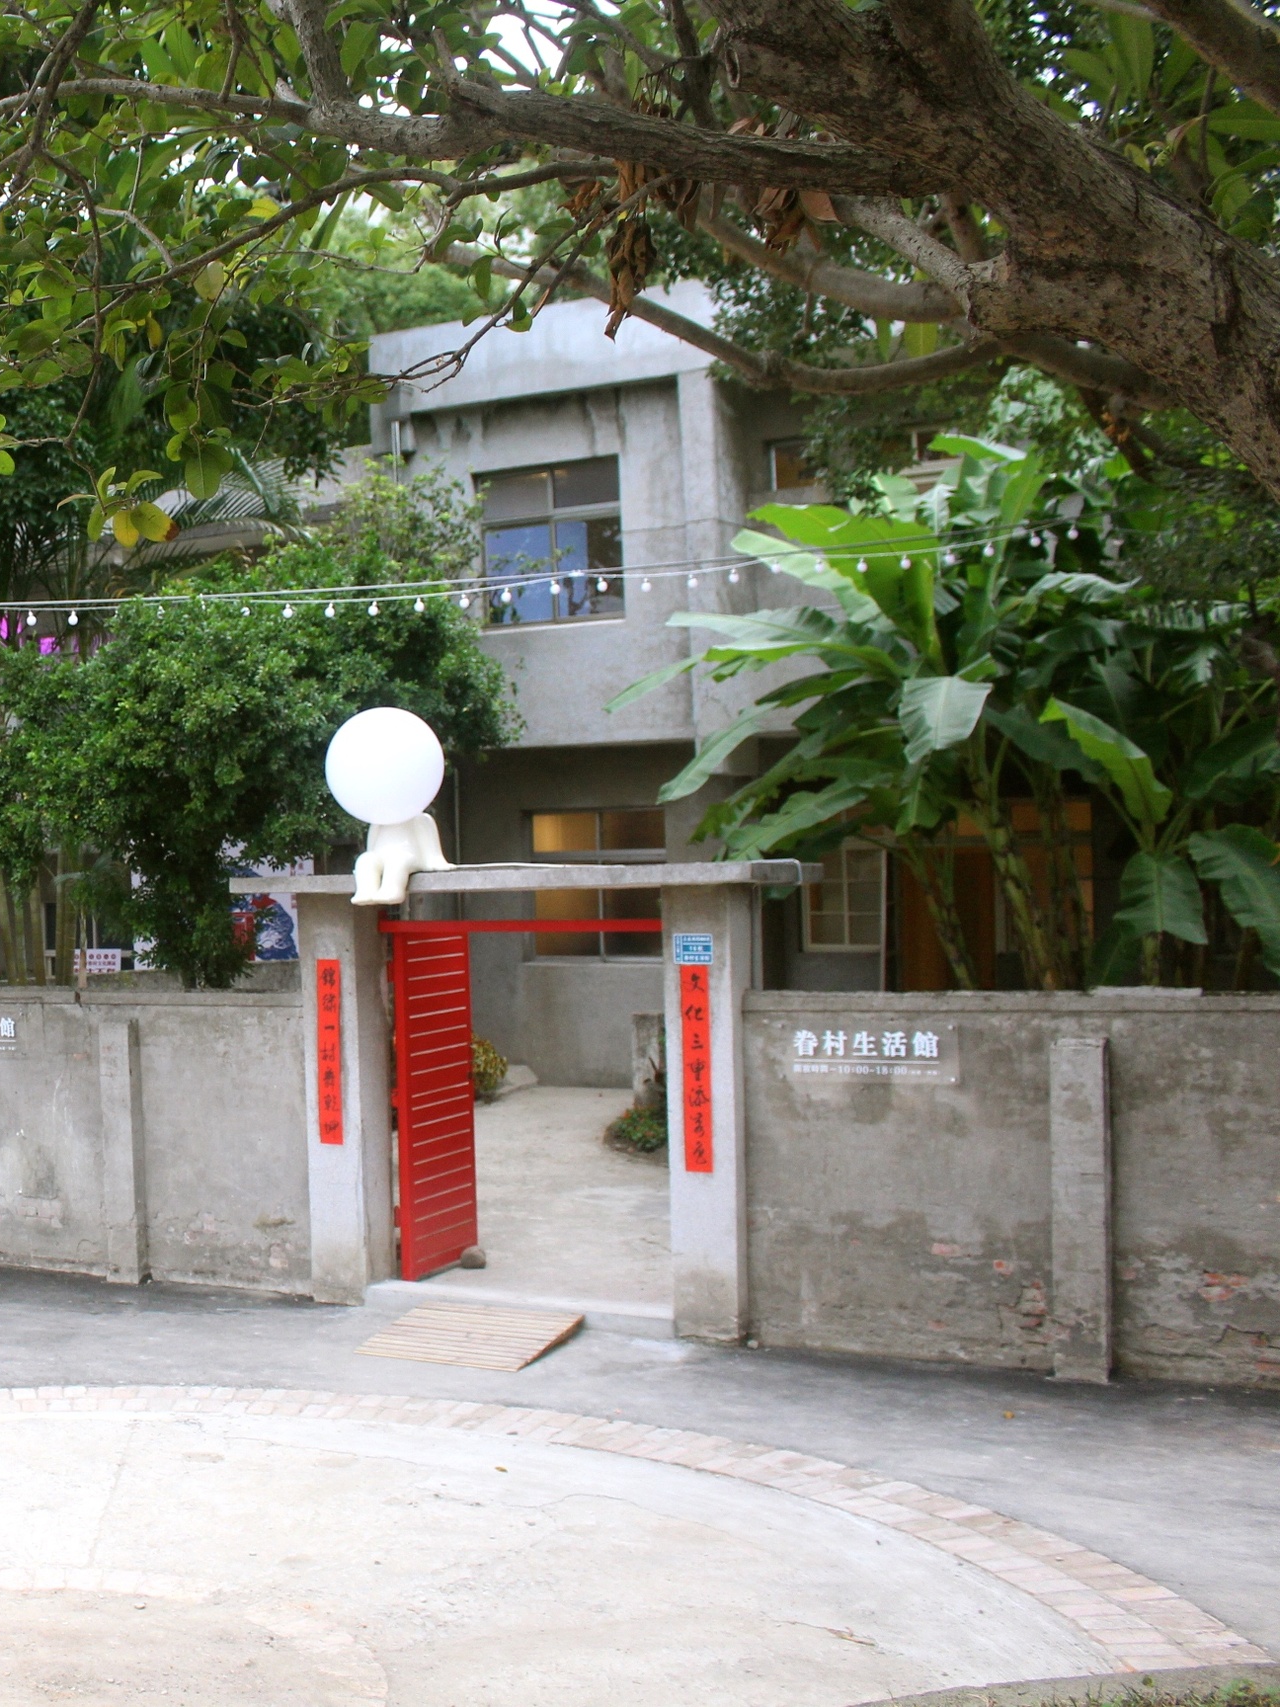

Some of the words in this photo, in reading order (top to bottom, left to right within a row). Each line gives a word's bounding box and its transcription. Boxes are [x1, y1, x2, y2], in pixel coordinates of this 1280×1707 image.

[793, 1029, 940, 1058] 眷村生活館
